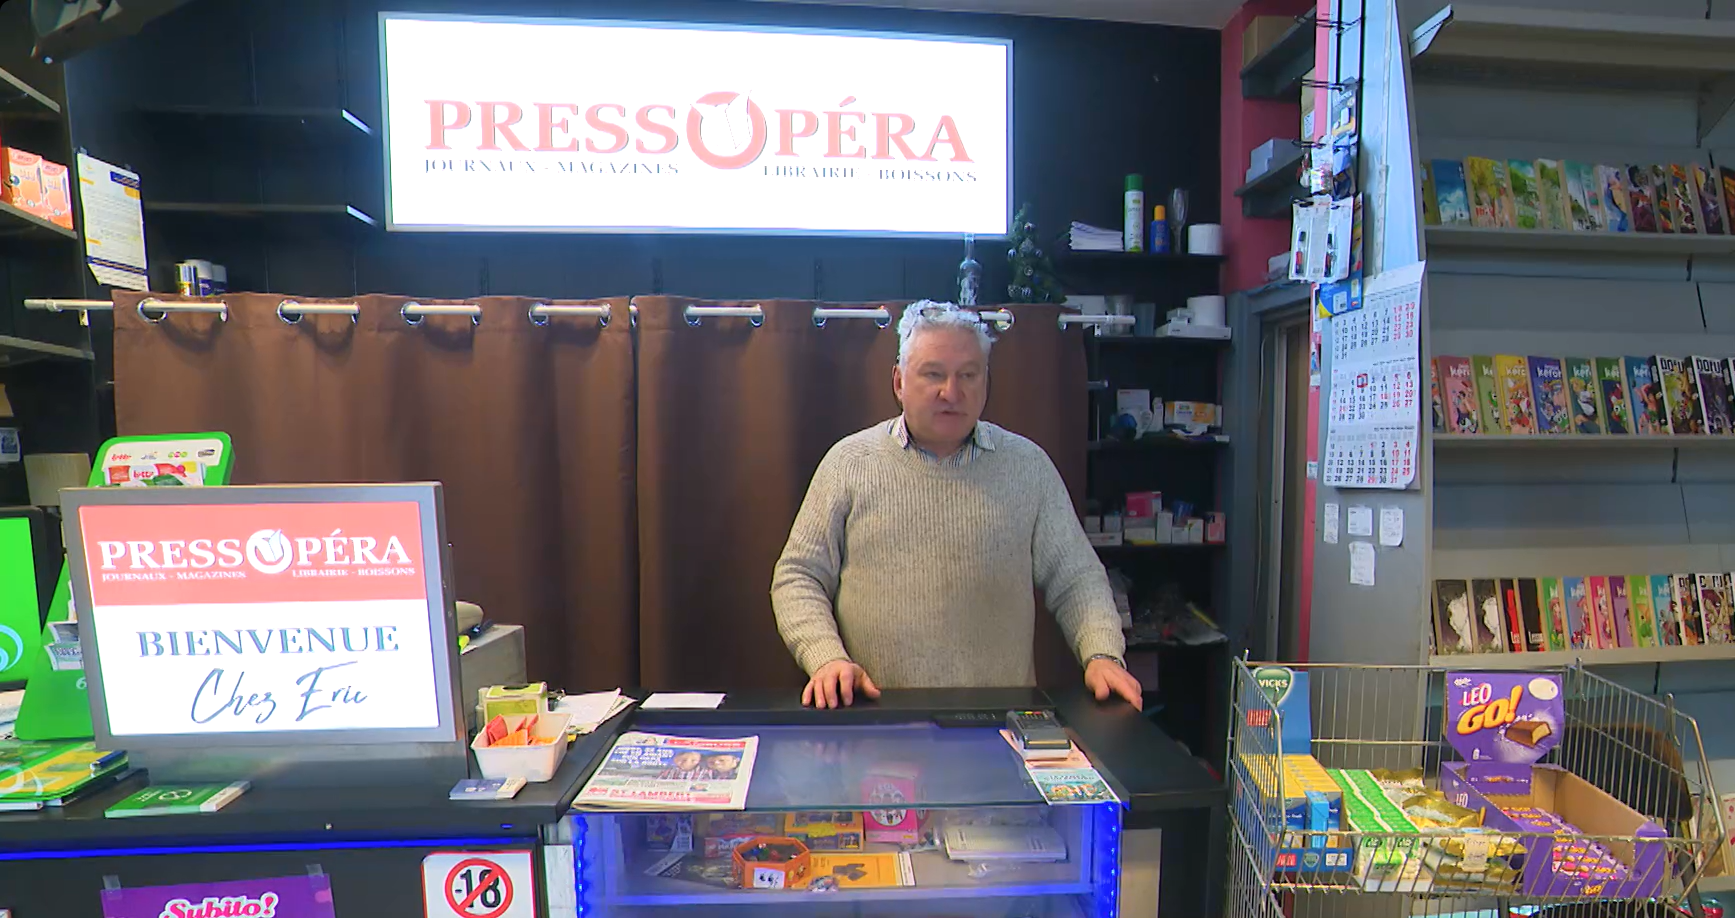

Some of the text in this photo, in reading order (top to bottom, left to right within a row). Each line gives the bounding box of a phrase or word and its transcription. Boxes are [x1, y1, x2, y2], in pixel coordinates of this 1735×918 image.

[425, 159, 536, 173] JOURNAUX
[102, 571, 167, 582] JOURNAUX
[176, 570, 247, 580] MAGAZINES
[292, 569, 349, 577] LIBRAIRIE
[357, 567, 416, 576] BOISSONS
[136, 626, 399, 657] BIENVENUE
[191, 661, 368, 724] Chez Eric
[1258, 679, 1288, 688] VICKS
[1462, 682, 1492, 706] LEO
[1457, 685, 1524, 735] GO!
[455, 869, 501, 908] -18
[163, 895, 275, 918] Subito!
